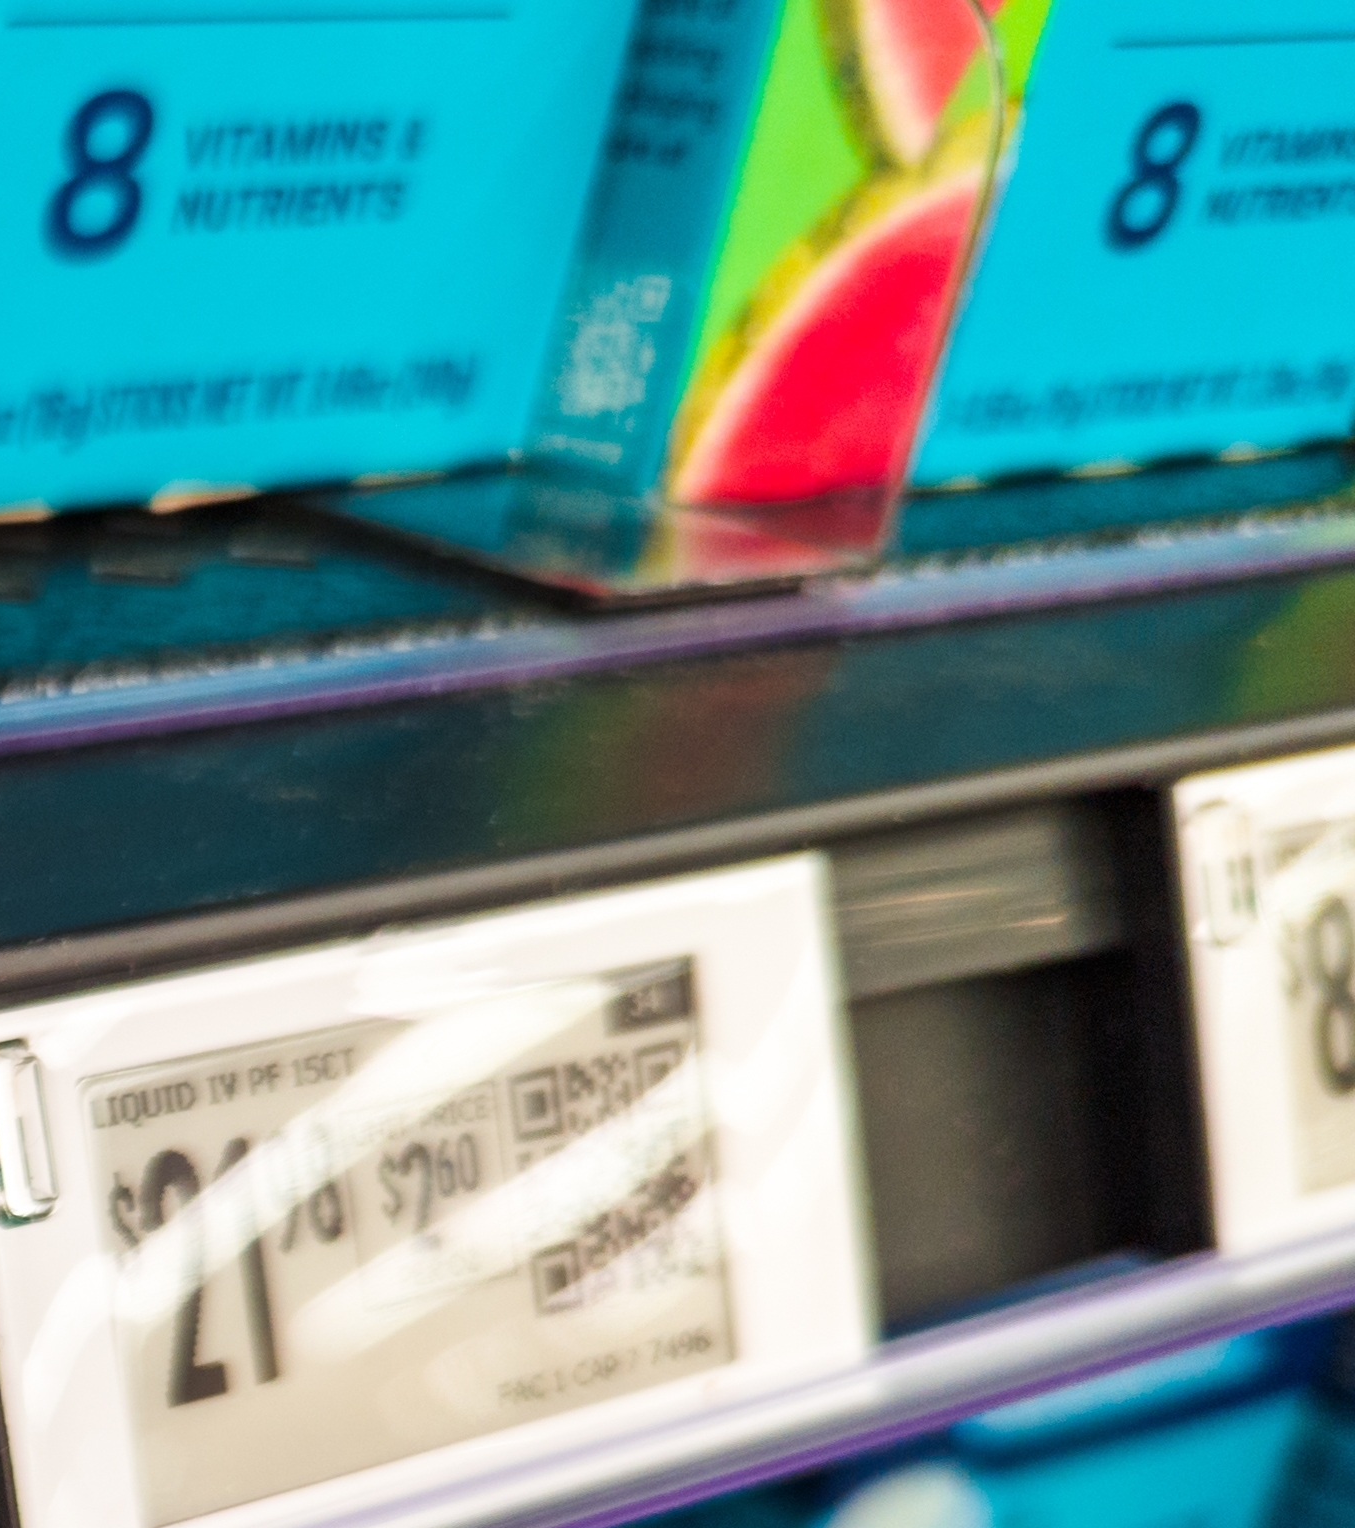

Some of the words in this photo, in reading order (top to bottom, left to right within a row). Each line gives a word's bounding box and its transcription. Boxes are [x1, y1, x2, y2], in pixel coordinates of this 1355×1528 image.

[41, 88, 155, 266] 8
[182, 116, 390, 173] VITAMINS
[1101, 100, 1202, 255] 8
[170, 177, 409, 238] NUTRIENTS
